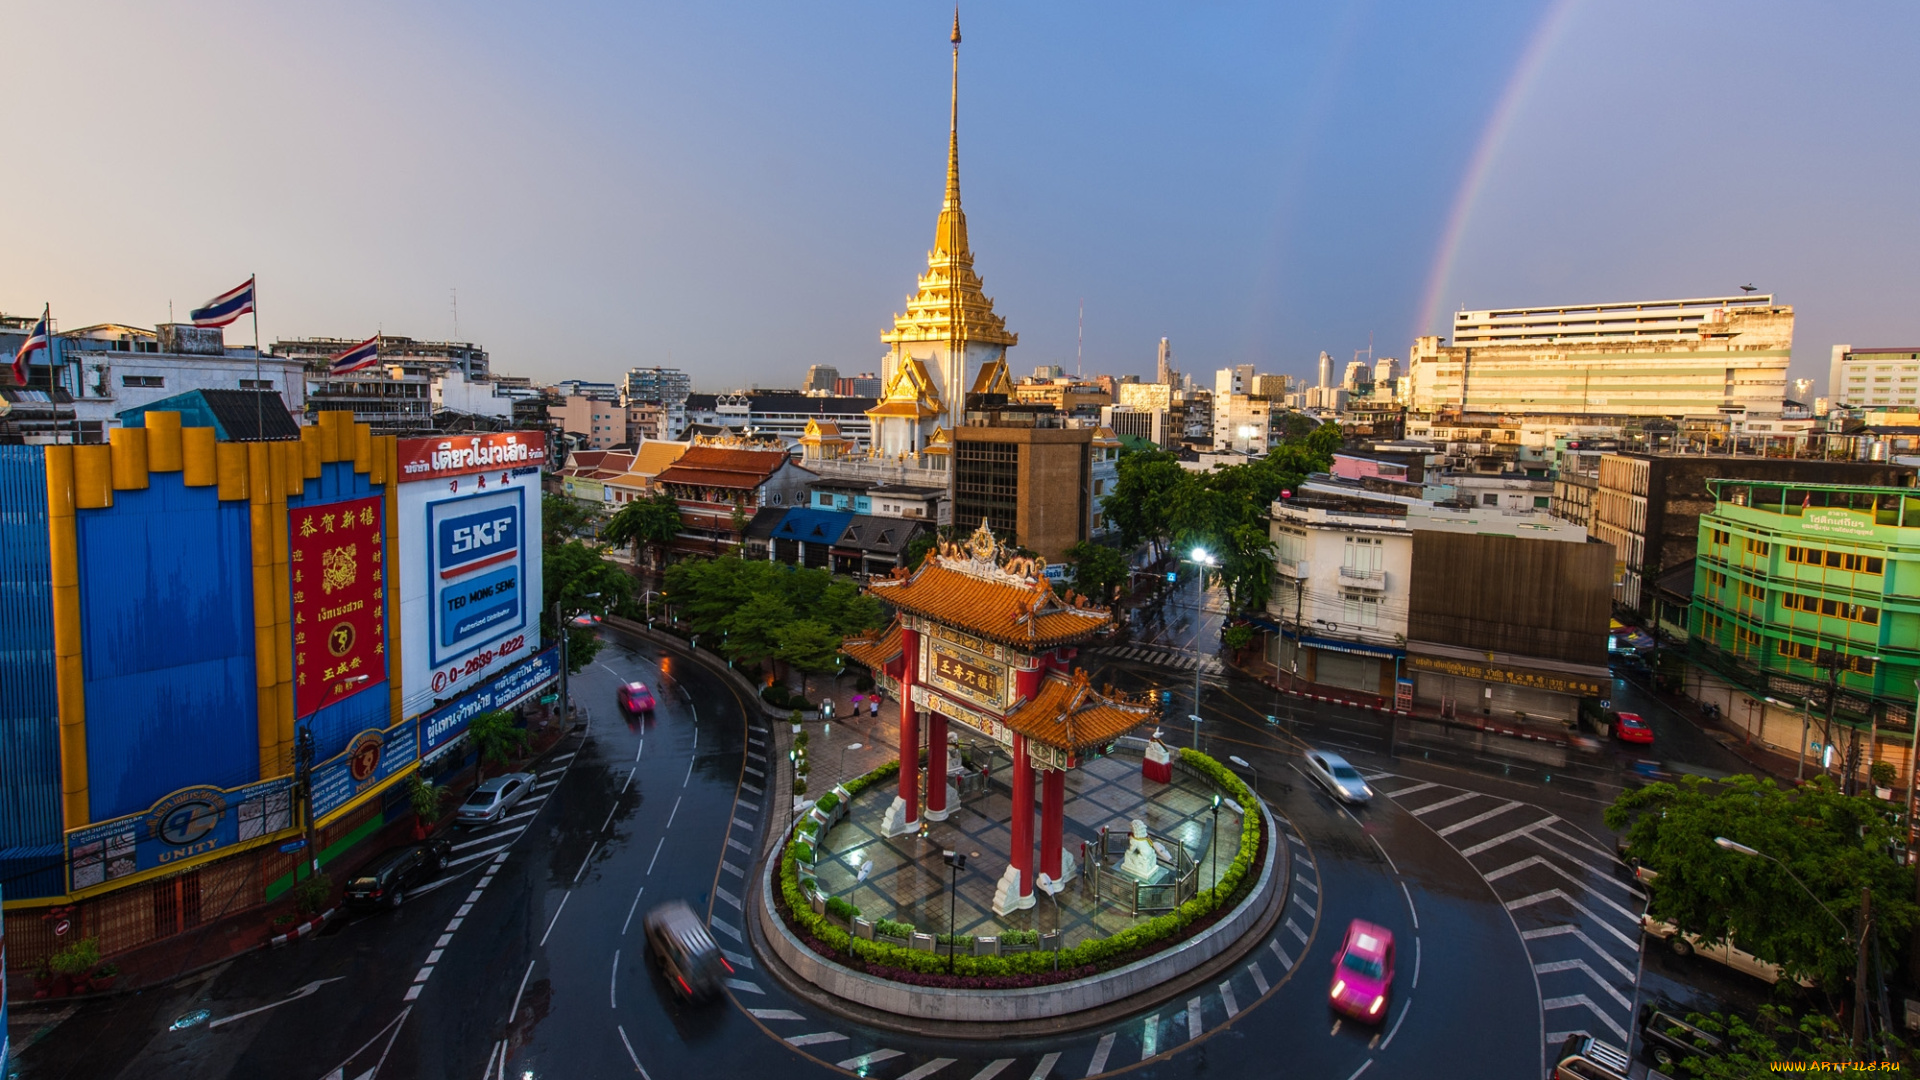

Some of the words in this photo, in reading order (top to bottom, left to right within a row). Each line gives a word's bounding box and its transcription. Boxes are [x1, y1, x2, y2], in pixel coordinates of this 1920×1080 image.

[403, 459, 430, 474] บริษัท
[451, 516, 512, 555] SKF
[447, 595, 467, 612] TEO
[469, 585, 494, 605] MONG
[495, 577, 516, 595] SENG
[459, 616, 487, 635] Authorized
[486, 607, 511, 623] Distributor
[448, 634, 525, 684] 0-2639-4222
[426, 692, 492, 748] ผู้แทนจำหน่าย
[157, 838, 219, 864] UNITY
